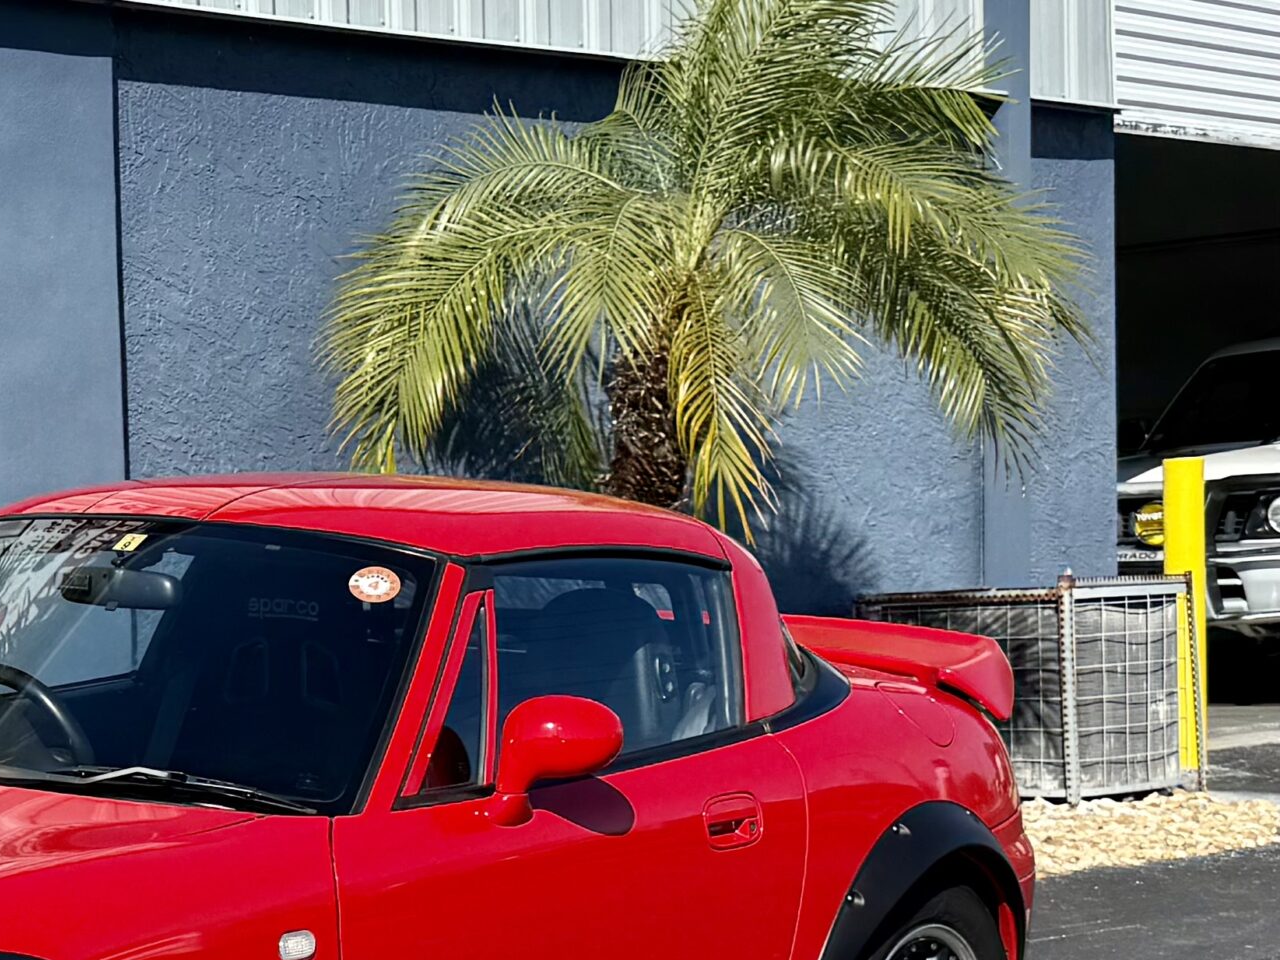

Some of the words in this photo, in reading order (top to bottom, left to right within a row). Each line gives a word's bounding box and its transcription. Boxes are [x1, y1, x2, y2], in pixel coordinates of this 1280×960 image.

[1135, 511, 1163, 521] TOYOT
[1117, 552, 1158, 560] RADO
[248, 597, 319, 620] sparco
